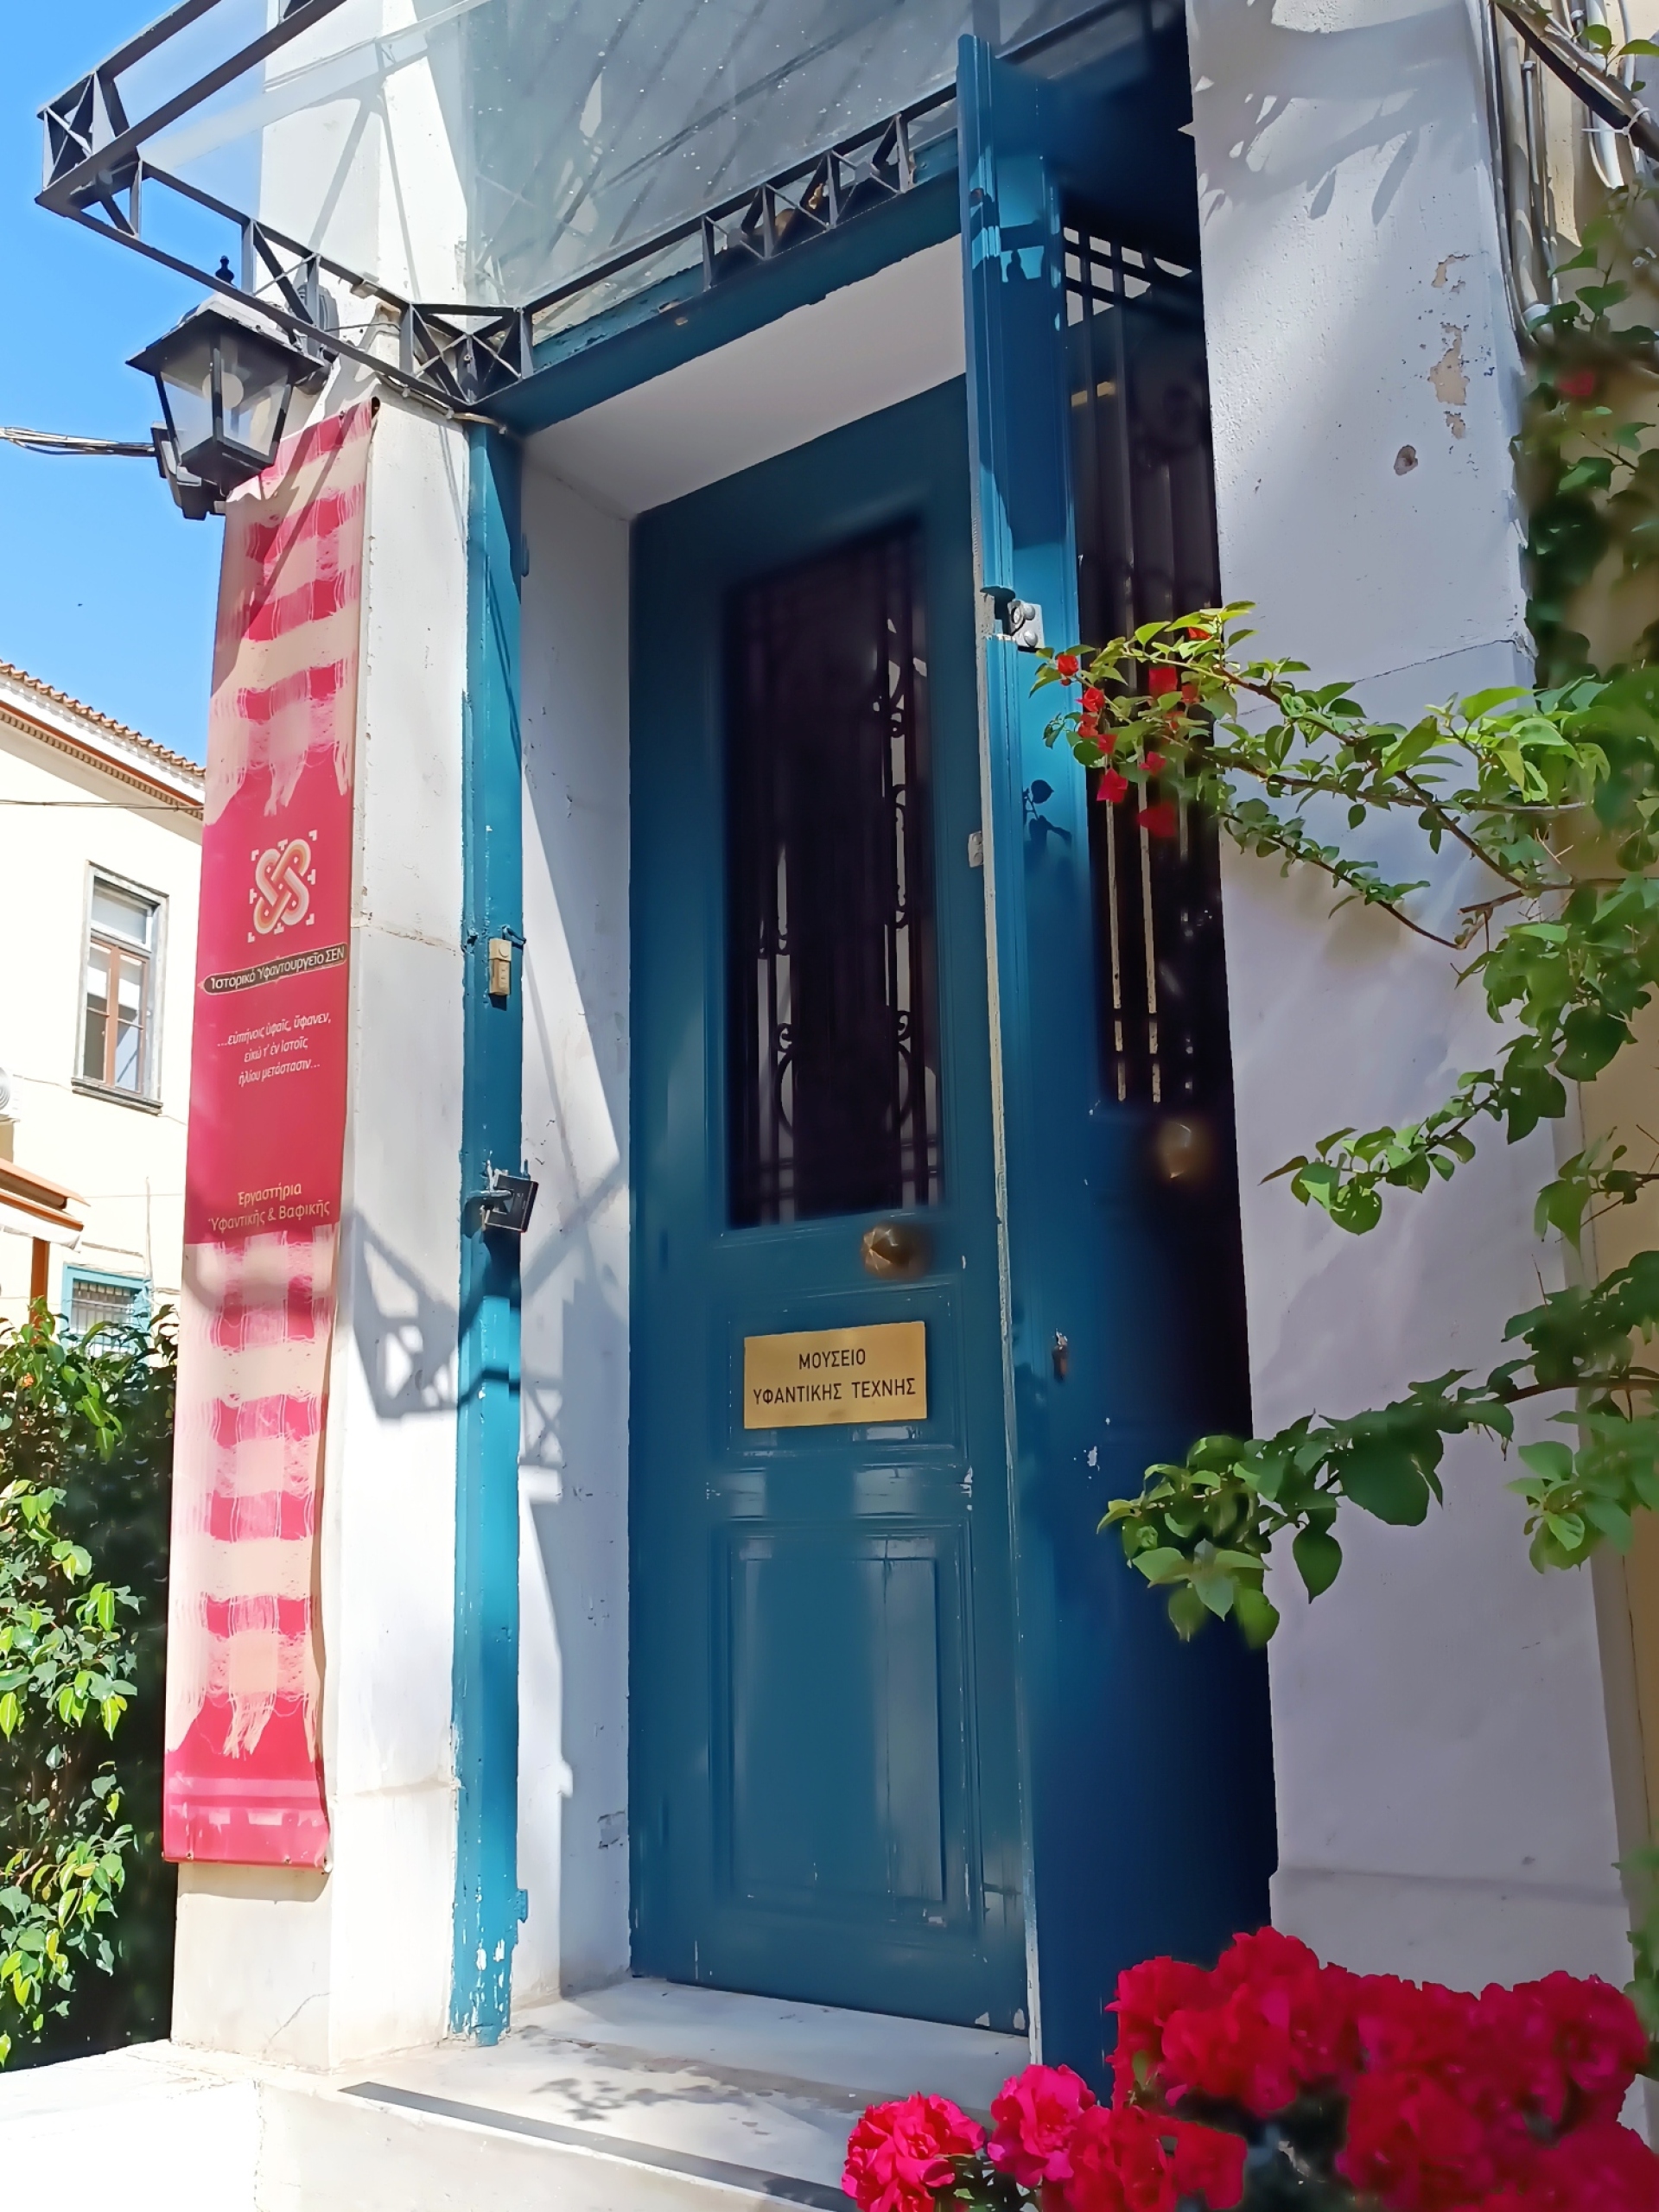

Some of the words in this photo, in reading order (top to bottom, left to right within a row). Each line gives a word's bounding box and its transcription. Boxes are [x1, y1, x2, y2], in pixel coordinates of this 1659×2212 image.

[267, 1206, 276, 1223] &
[798, 1348, 867, 1370] ΜΟΥΣΕΙΟ
[753, 1382, 843, 1406] ΥΦΑΝΤΙΚΗΣ
[851, 1377, 917, 1399] ΤΕΧΝΗΣ
